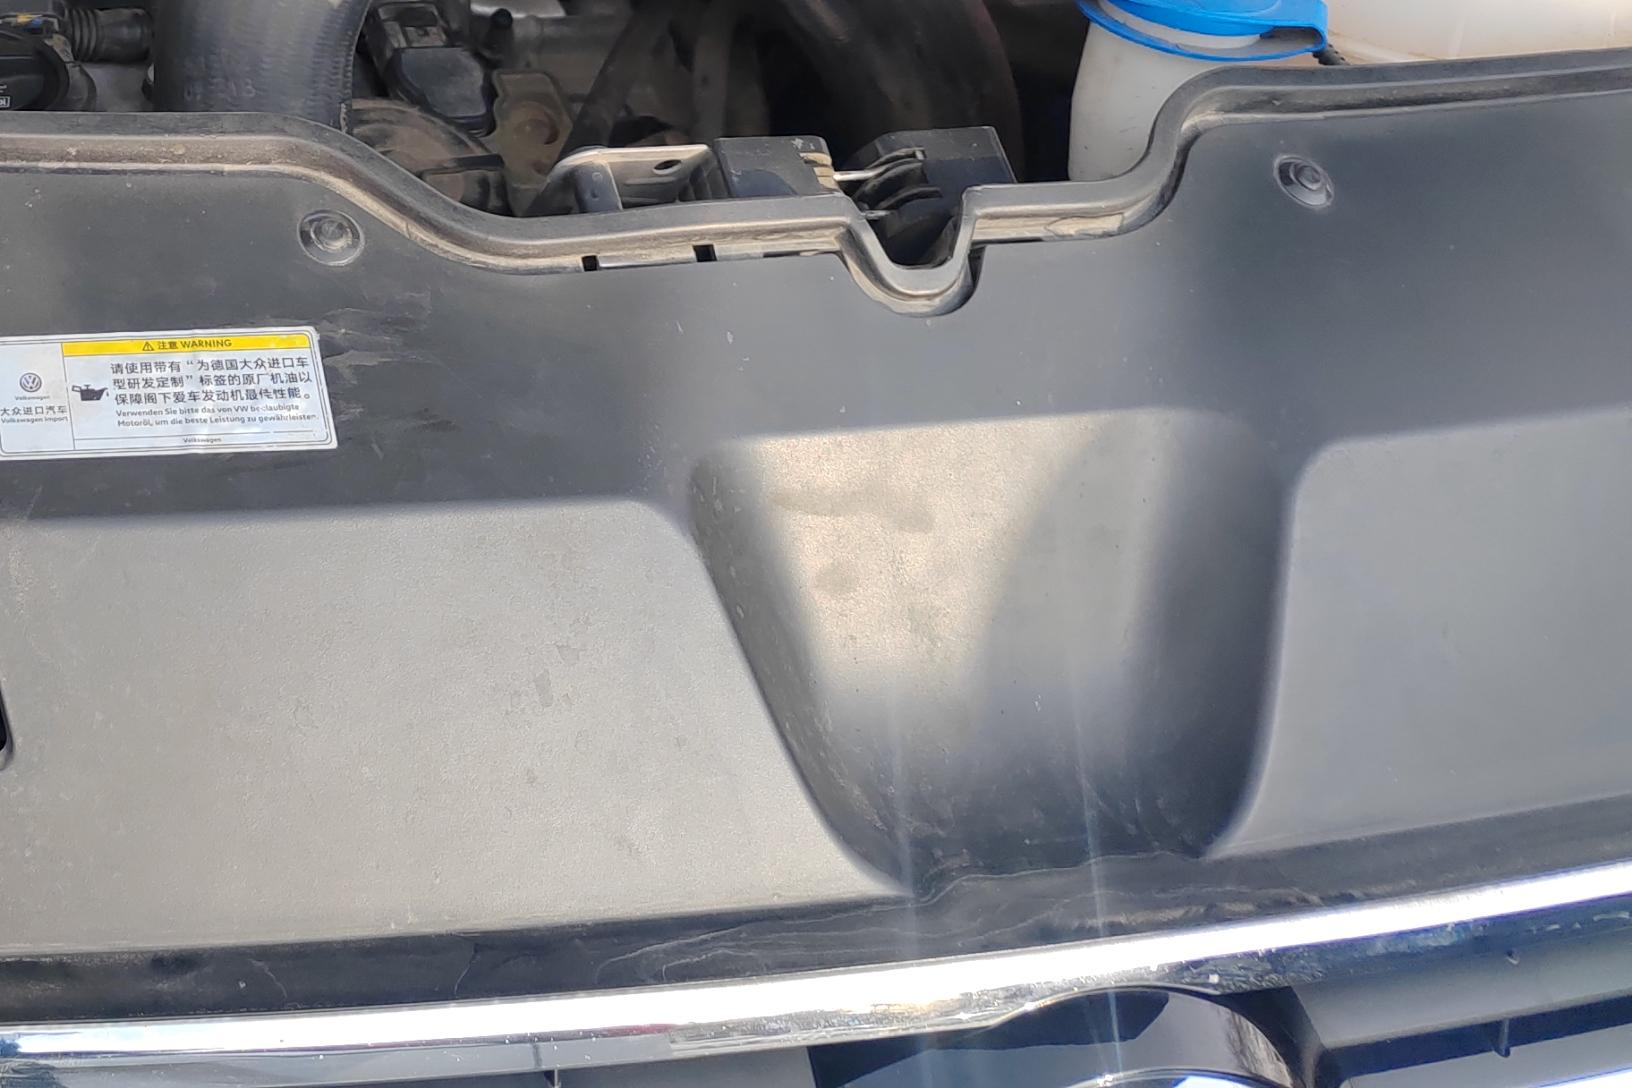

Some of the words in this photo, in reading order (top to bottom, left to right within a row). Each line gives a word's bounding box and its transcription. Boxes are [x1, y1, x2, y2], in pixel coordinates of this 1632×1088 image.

[157, 340, 178, 350] 注意
[180, 339, 232, 349] WARNING
[0, 405, 67, 417] 大众进口汽车
[116, 408, 164, 417] Verwenden
[179, 406, 199, 415] bitte
[201, 406, 215, 414] das
[233, 405, 248, 413] VW
[170, 416, 183, 425] die
[185, 415, 208, 424] beste
[209, 414, 245, 425] Leistung
